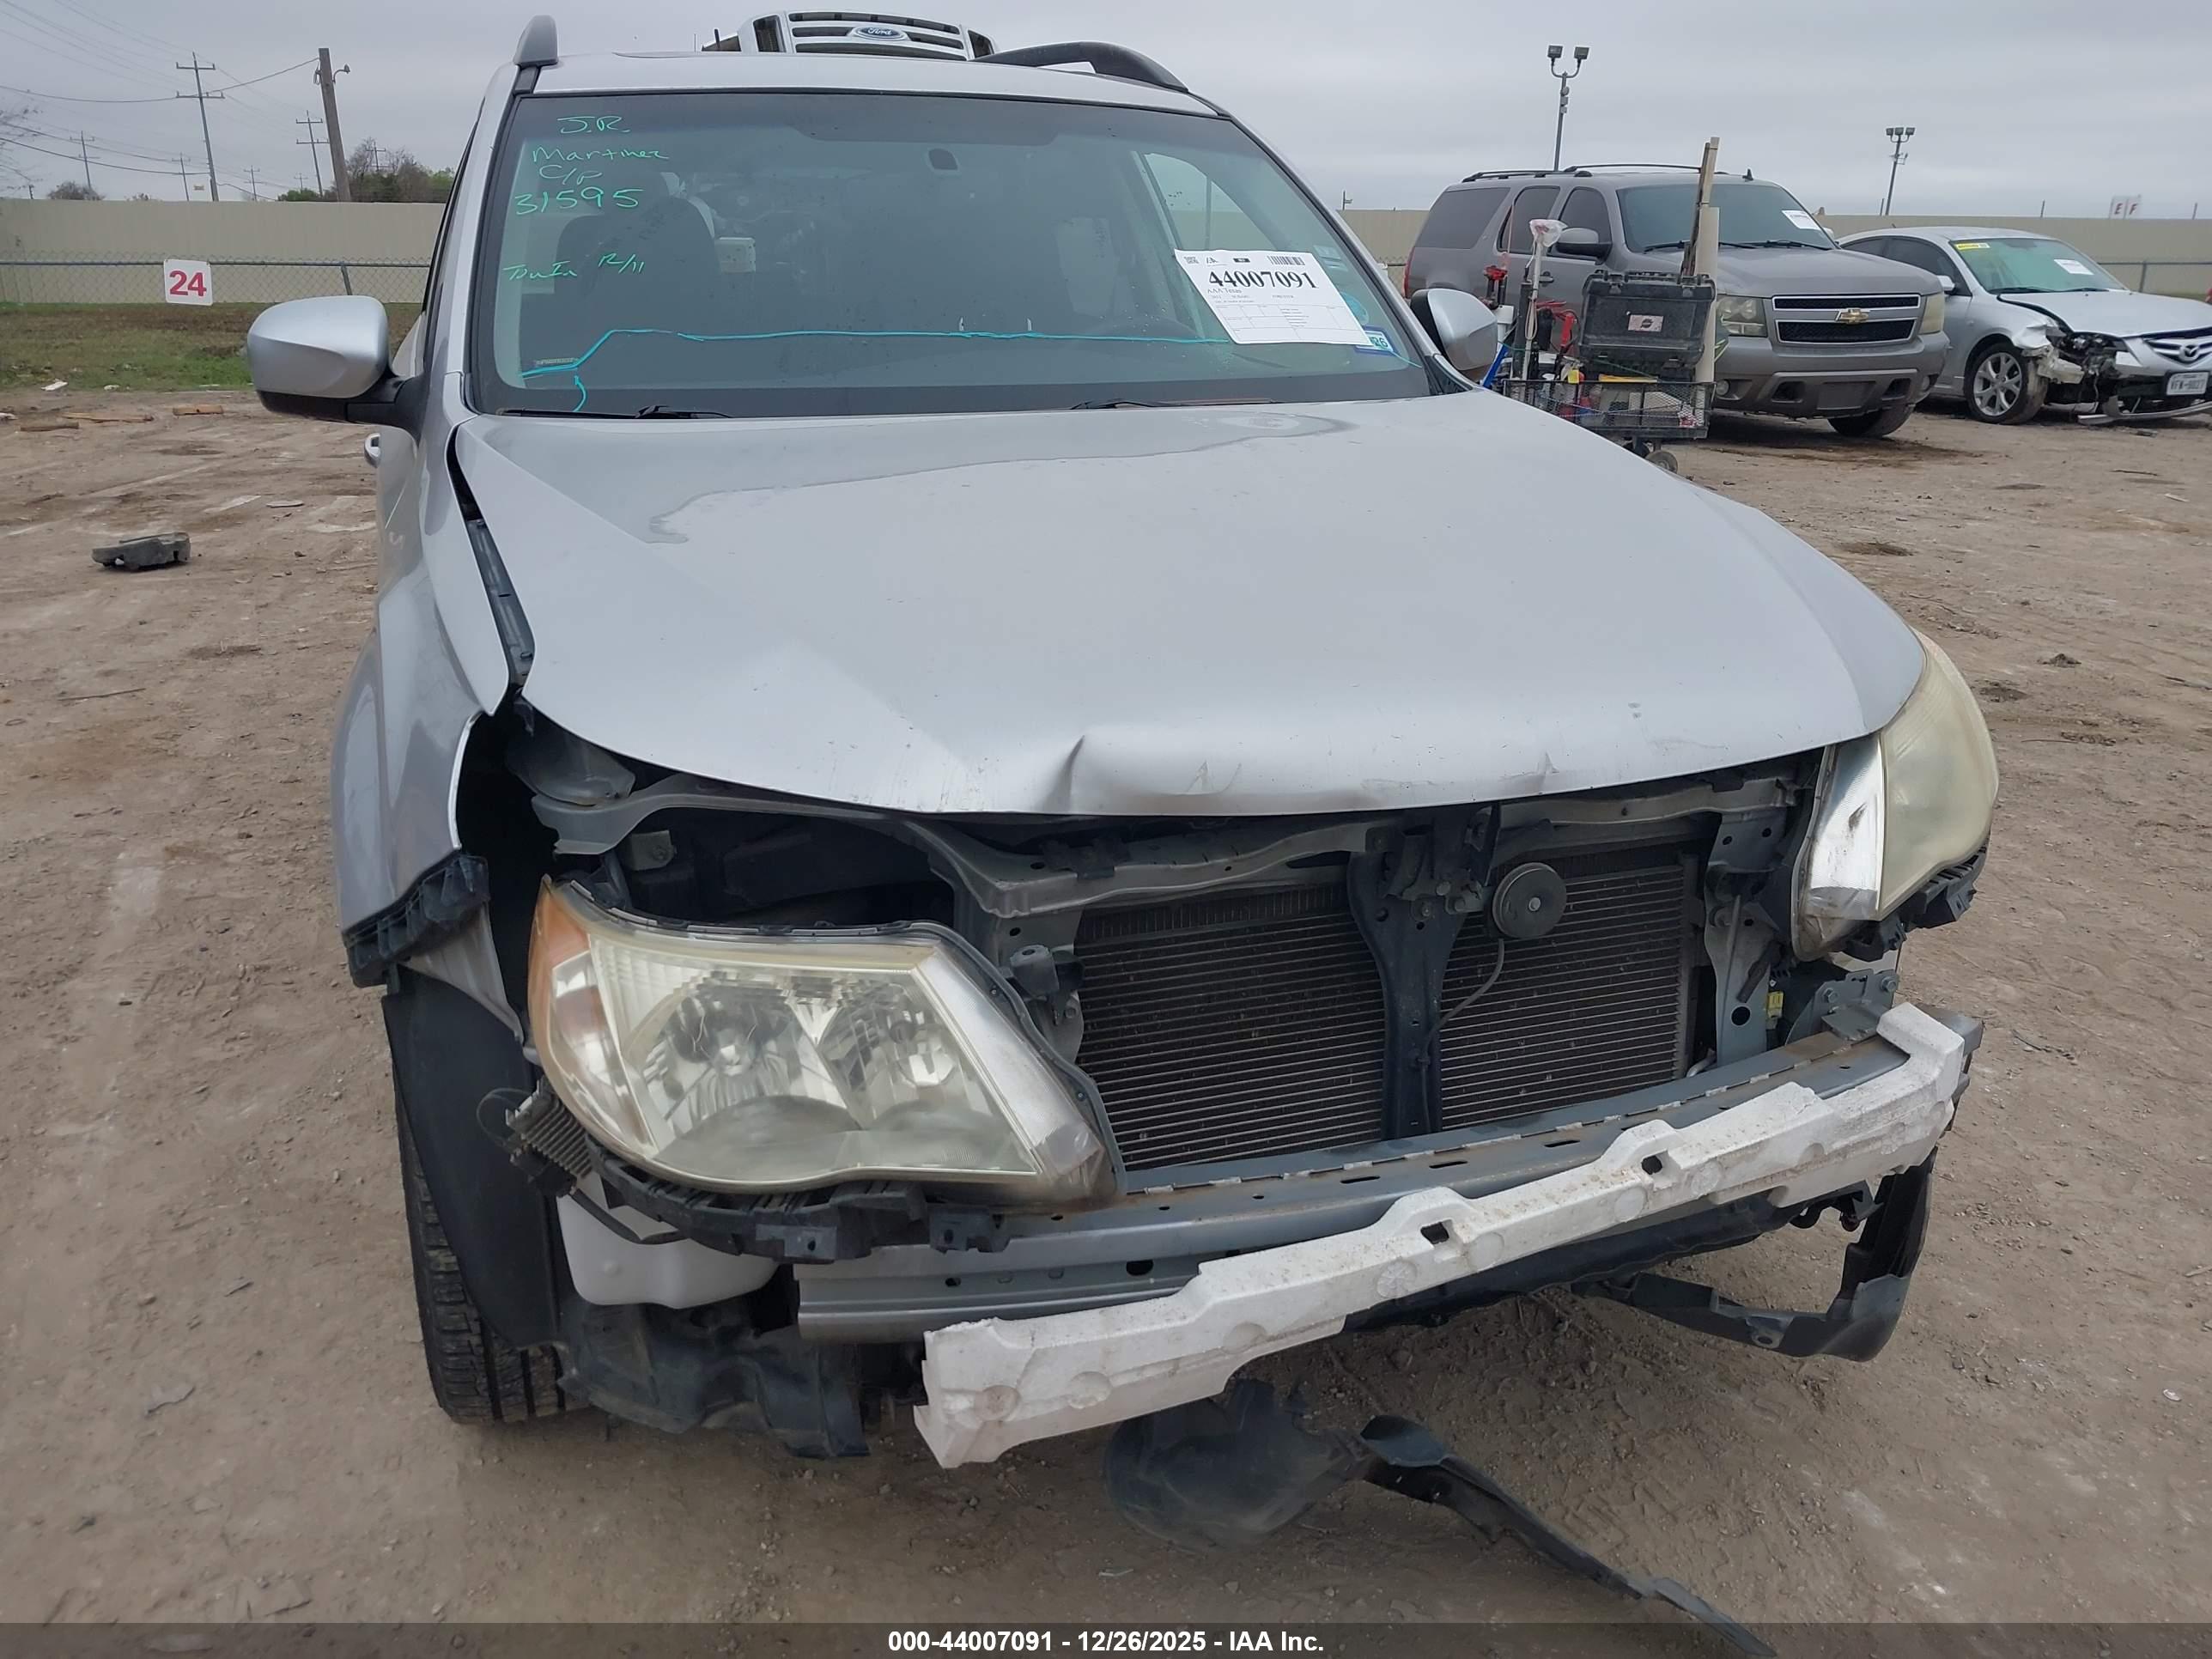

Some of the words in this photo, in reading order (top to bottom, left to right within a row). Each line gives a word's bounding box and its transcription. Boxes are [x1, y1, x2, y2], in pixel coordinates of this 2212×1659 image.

[867, 27, 893, 35] Ford
[514, 185, 645, 216] 31595
[2114, 203, 2124, 215] E
[169, 270, 208, 297] 24
[1208, 270, 1319, 289] 44007091
